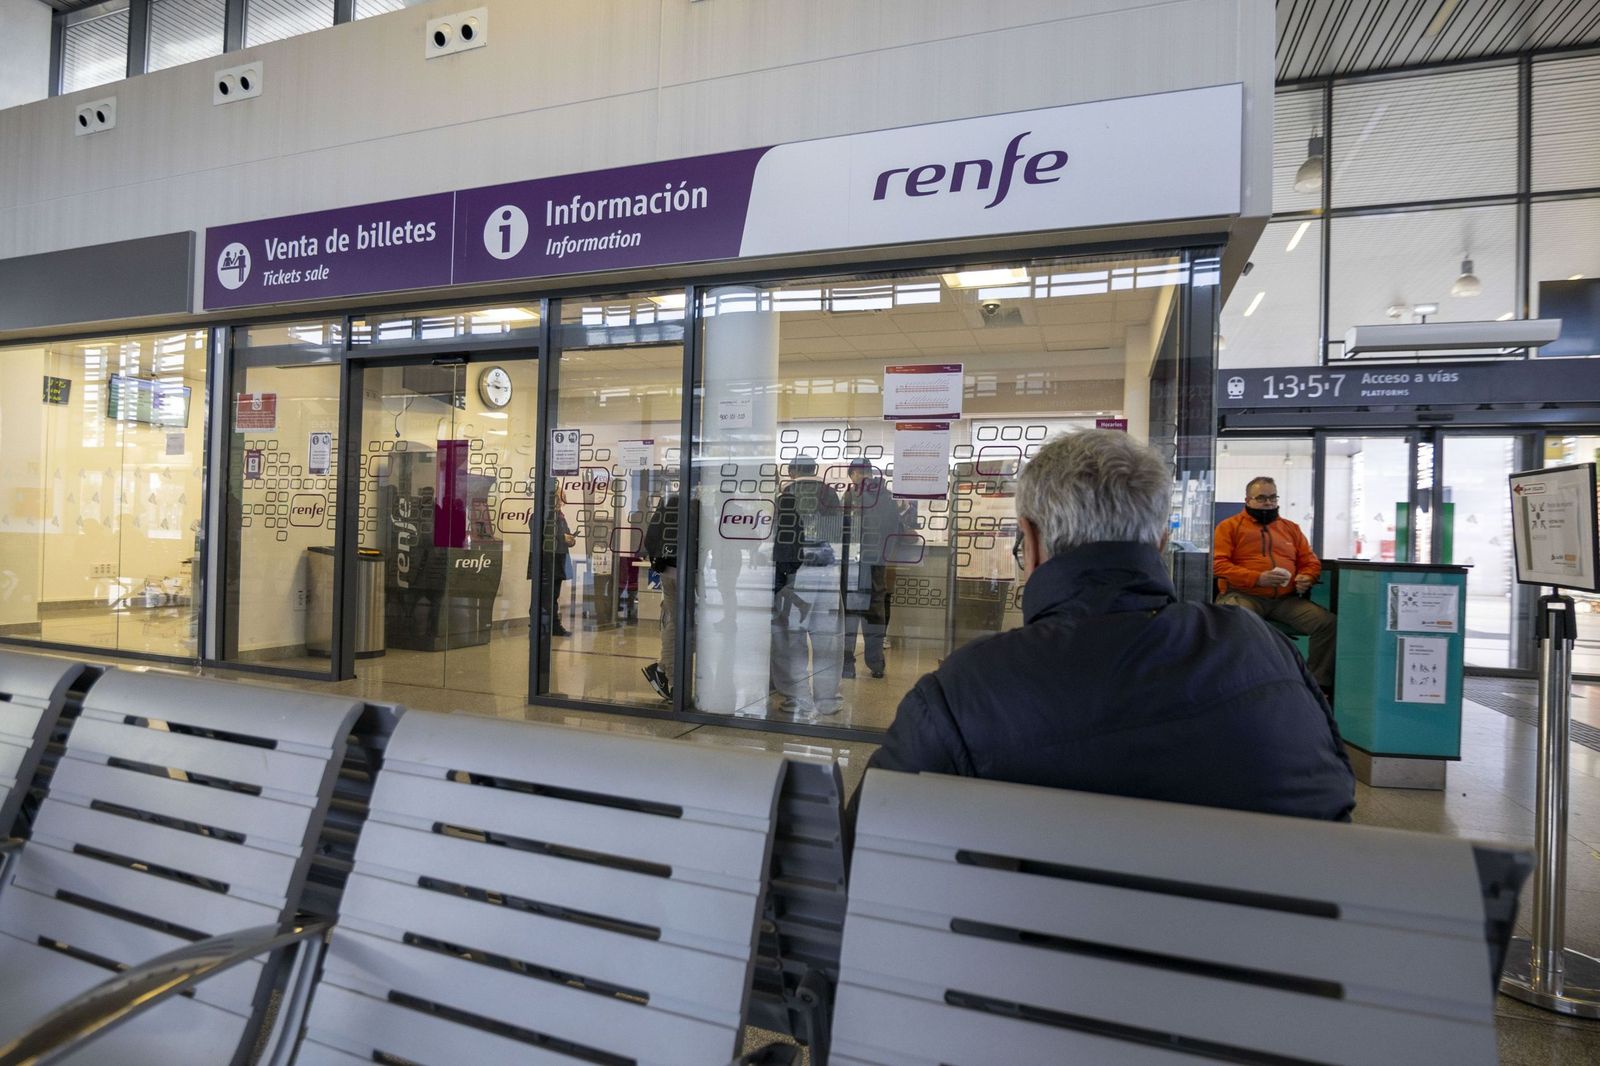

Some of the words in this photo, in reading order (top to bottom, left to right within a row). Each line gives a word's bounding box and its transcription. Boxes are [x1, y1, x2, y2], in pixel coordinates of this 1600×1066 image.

[873, 131, 1069, 209] renfe
[546, 180, 708, 227] Información
[265, 236, 318, 261] Venta
[325, 228, 350, 254] de
[357, 220, 437, 250] billetes
[546, 229, 642, 259] Information
[263, 270, 301, 286] Tickets
[304, 264, 330, 281] sale
[1361, 373, 1410, 385] Acceso
[1414, 373, 1423, 383] a
[1428, 369, 1459, 383] vías
[1361, 389, 1409, 397] PLATFORMS
[564, 475, 607, 496] renfe
[291, 502, 324, 519] renfe
[723, 509, 772, 530] renfe
[391, 497, 418, 589] renfe
[455, 553, 492, 573] renfe
